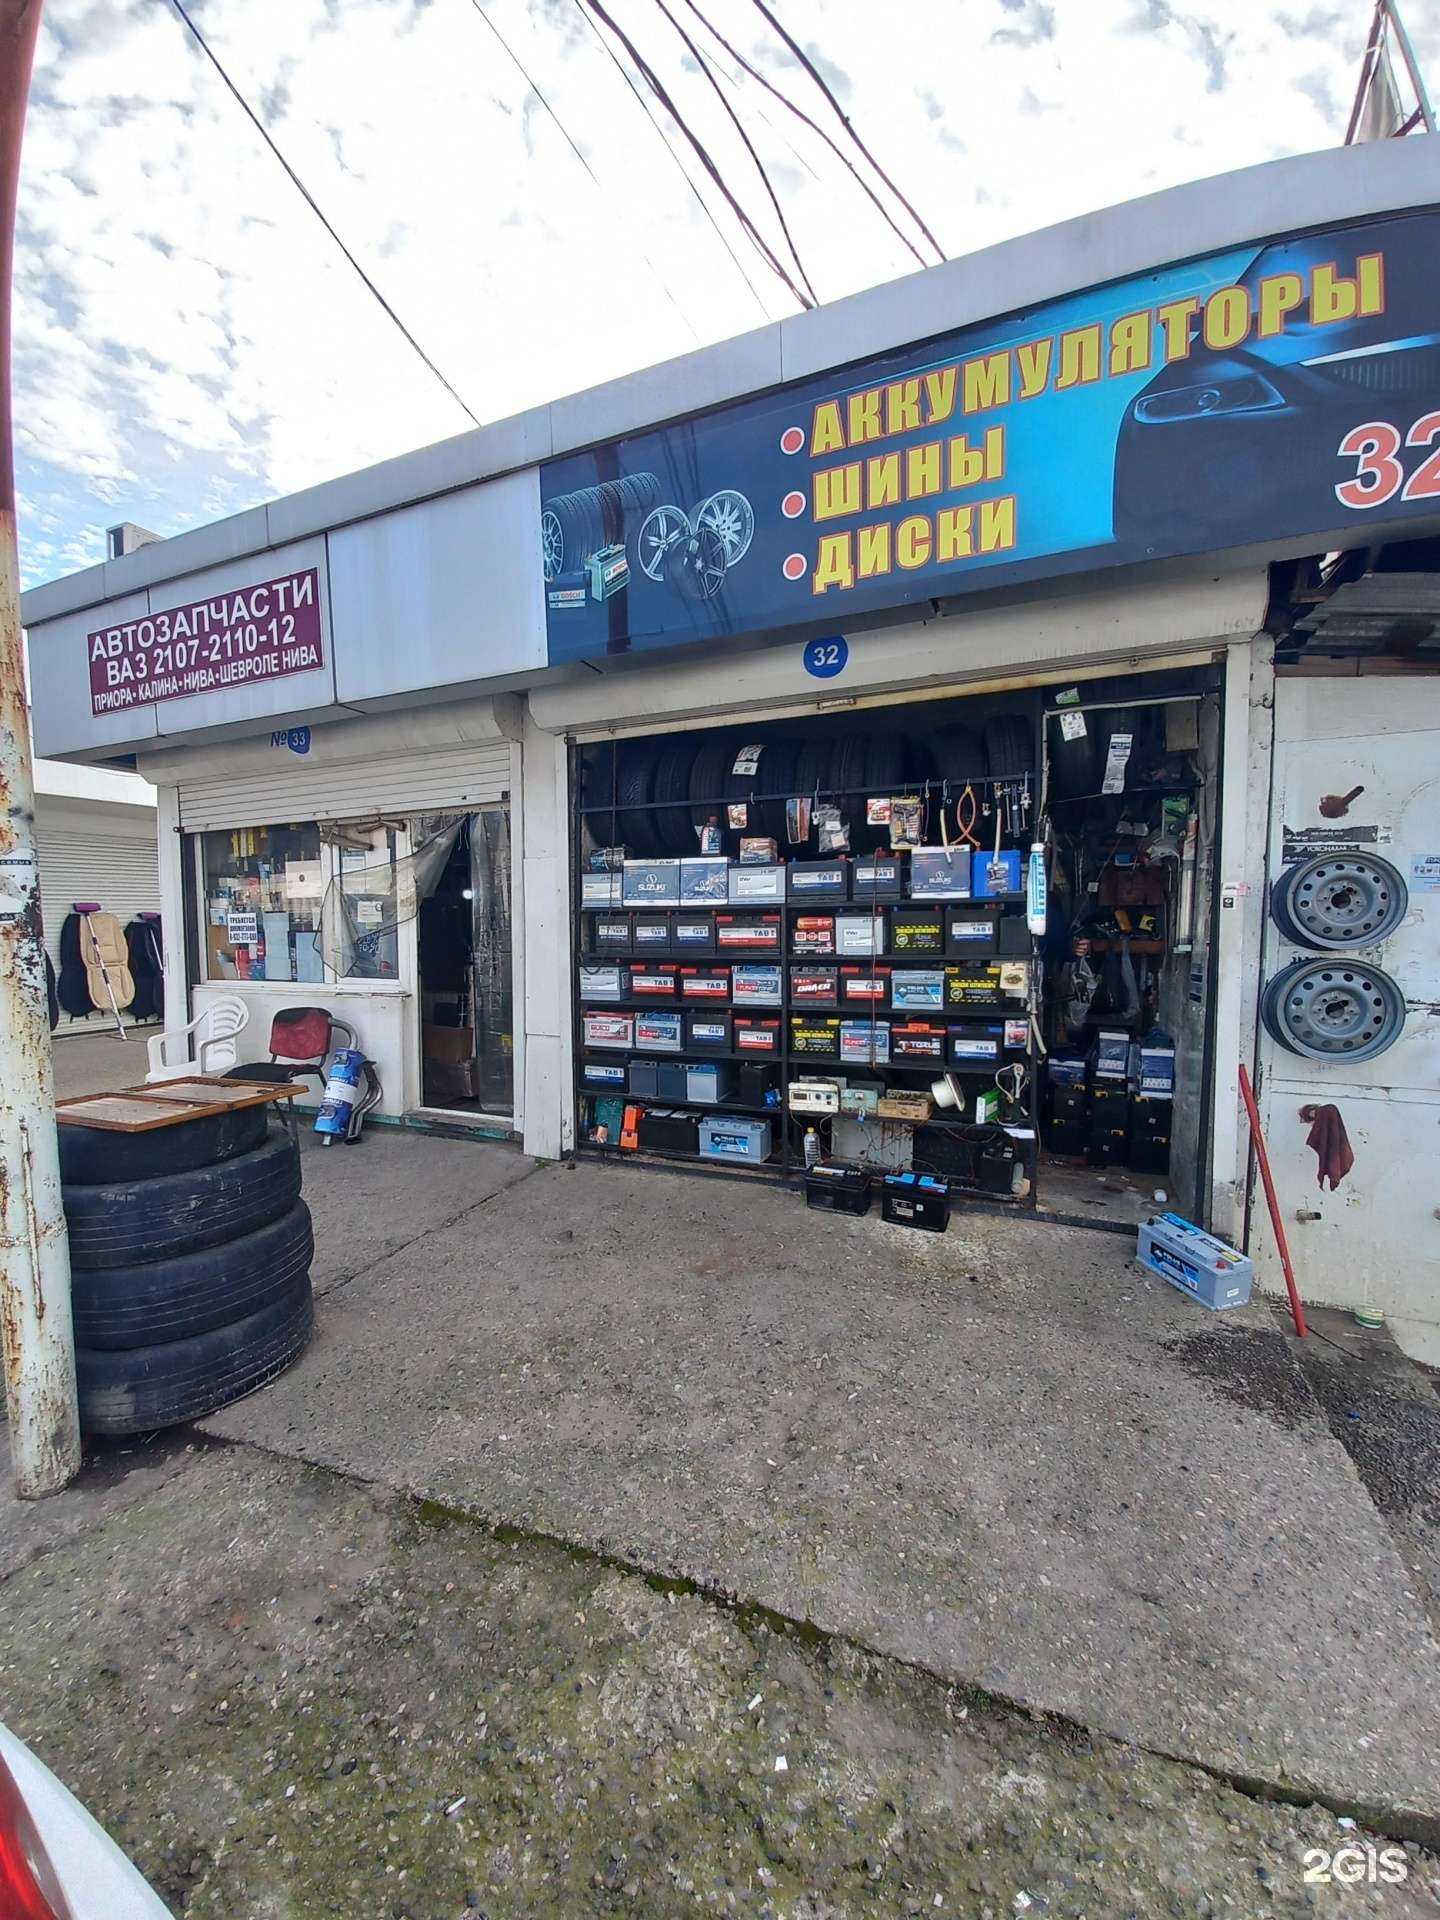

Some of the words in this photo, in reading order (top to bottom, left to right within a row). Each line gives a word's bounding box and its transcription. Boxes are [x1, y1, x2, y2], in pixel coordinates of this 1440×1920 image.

[809, 252, 1386, 458] АККУМУЛЯТОРЫ
[813, 423, 1006, 523] ШИНЫ
[812, 495, 1016, 595] ДИСКИ
[91, 574, 313, 662] АВТОЗАПЧАСТИ
[106, 651, 147, 686] ВАЗ
[153, 614, 296, 675] 2107-2110-12
[283, 644, 318, 669] НИВА
[813, 644, 839, 667] 32
[292, 731, 306, 747] 33
